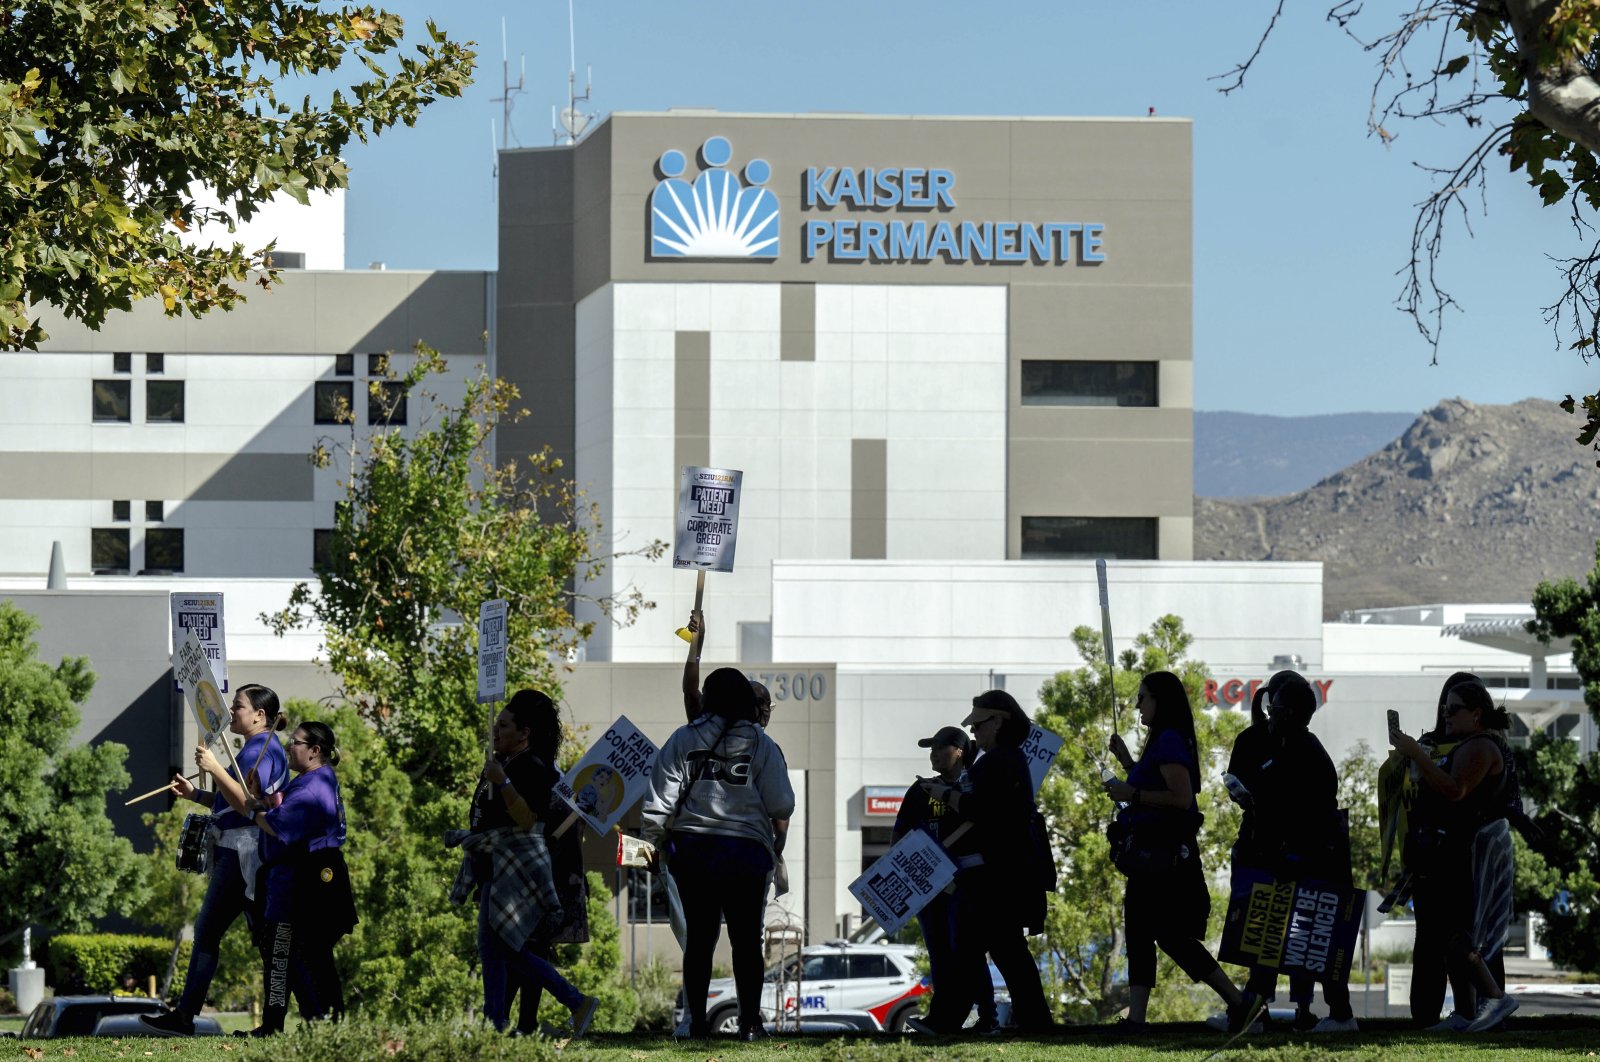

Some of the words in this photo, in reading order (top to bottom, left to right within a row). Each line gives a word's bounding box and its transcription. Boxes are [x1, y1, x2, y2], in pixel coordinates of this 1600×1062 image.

[805, 166, 957, 208] KAISER
[805, 218, 1107, 263] PERMANENTE
[695, 486, 731, 503] PATIENT
[700, 500, 723, 514] NEED
[687, 519, 733, 535] CORPORATE
[696, 532, 721, 546] GREED
[182, 614, 215, 628] PATIENT
[179, 641, 193, 663] FAIR
[188, 664, 204, 689] NOW!
[604, 729, 653, 777] CONTRAC
[627, 731, 654, 759] FAIR
[606, 750, 638, 781] NOW!
[893, 850, 934, 895] CORPORATE
[909, 851, 935, 878] GREED
[871, 878, 905, 913] PATIENT
[887, 875, 911, 899] NEED
[1295, 887, 1319, 912] BE
[1244, 889, 1271, 947] KAISER
[1261, 879, 1293, 960] WORKERS
[1304, 891, 1339, 973] SILENCED
[273, 921, 292, 956] INK
[1284, 911, 1314, 967] WON'T
[268, 956, 289, 1007] PINK
